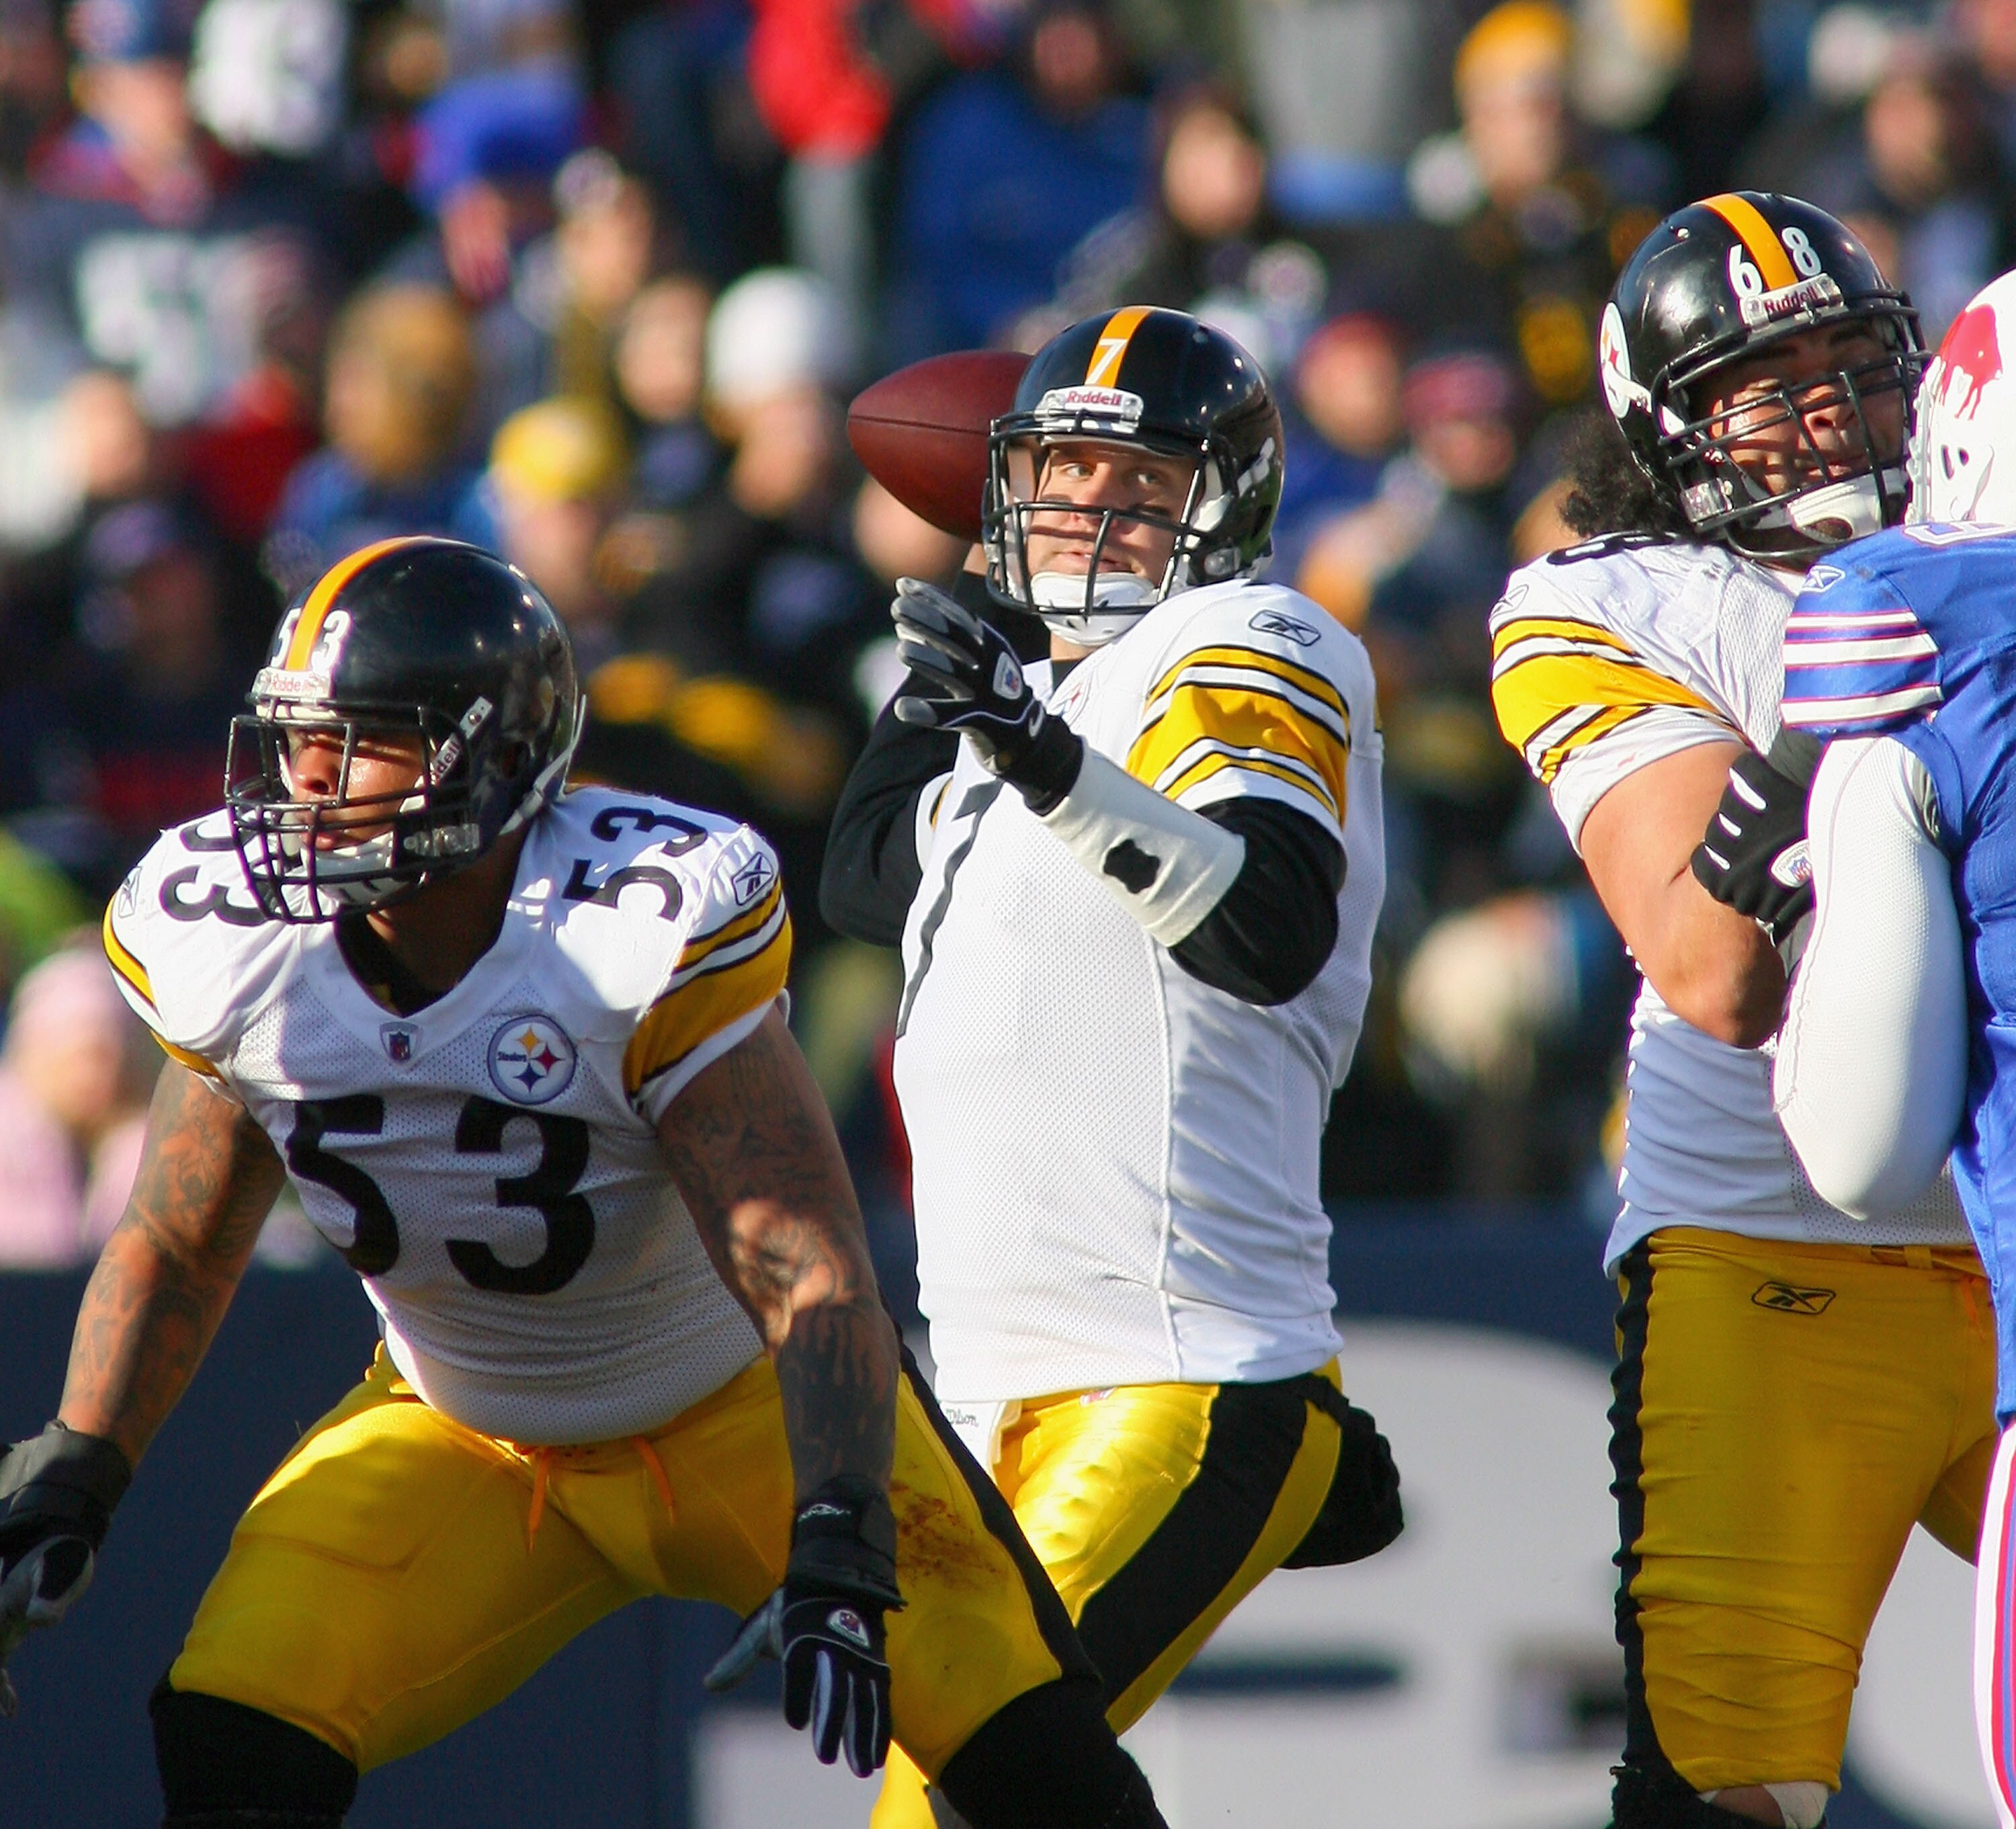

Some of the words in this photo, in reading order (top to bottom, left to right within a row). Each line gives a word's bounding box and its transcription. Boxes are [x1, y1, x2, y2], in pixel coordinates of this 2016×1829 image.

[1729, 226, 1822, 299] 68
[1066, 390, 1123, 406] Riddell
[1084, 338, 1128, 385] 7
[561, 806, 708, 923] 53
[286, 1094, 595, 1296] 53
